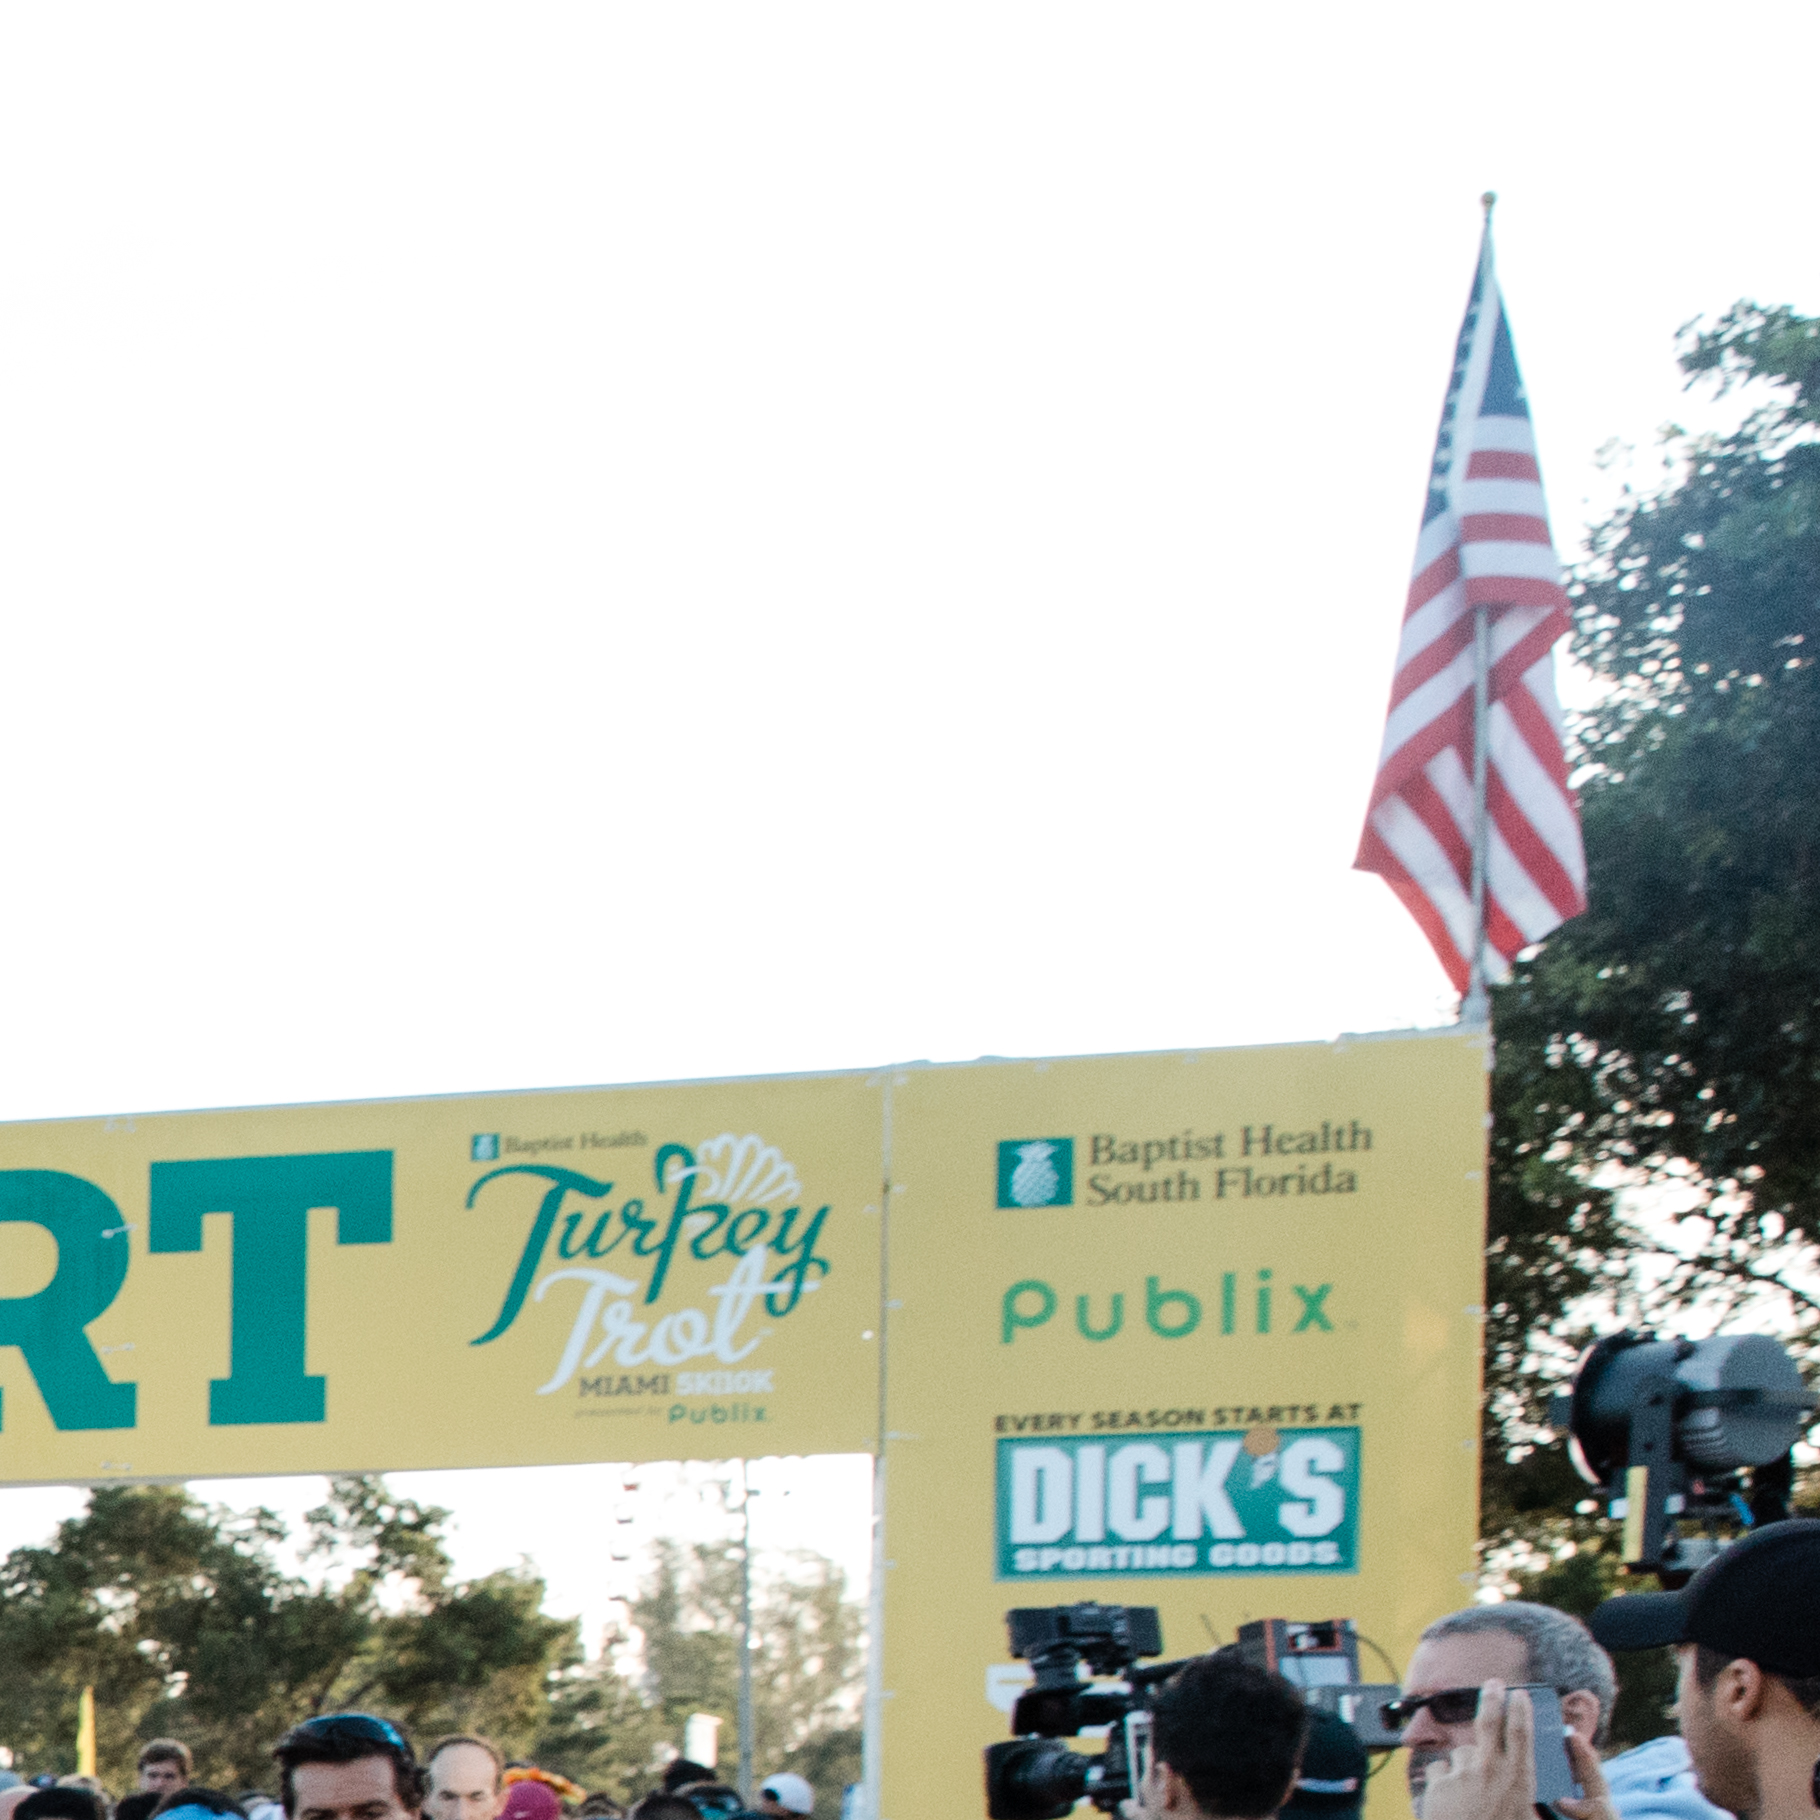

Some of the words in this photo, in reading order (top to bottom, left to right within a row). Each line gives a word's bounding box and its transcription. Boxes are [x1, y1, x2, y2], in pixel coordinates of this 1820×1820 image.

[1088, 1130, 1226, 1172] Baptist
[1240, 1119, 1374, 1157] Health
[1087, 1169, 1201, 1206] South
[1214, 1161, 1358, 1201] Florida
[464, 1142, 833, 1348] Turkey
[534, 1244, 822, 1396] Trot
[1000, 1268, 1335, 1344] Publix
[579, 1374, 671, 1398] MIAMI
[668, 1401, 768, 1424] Publix
[994, 1411, 1080, 1433] EVERY
[1091, 1407, 1206, 1429] SEASON
[1212, 1402, 1319, 1426] STARTS
[1327, 1401, 1363, 1421] AT
[1013, 1544, 1197, 1571] SPORTING
[1209, 1540, 1341, 1567] GOODS
